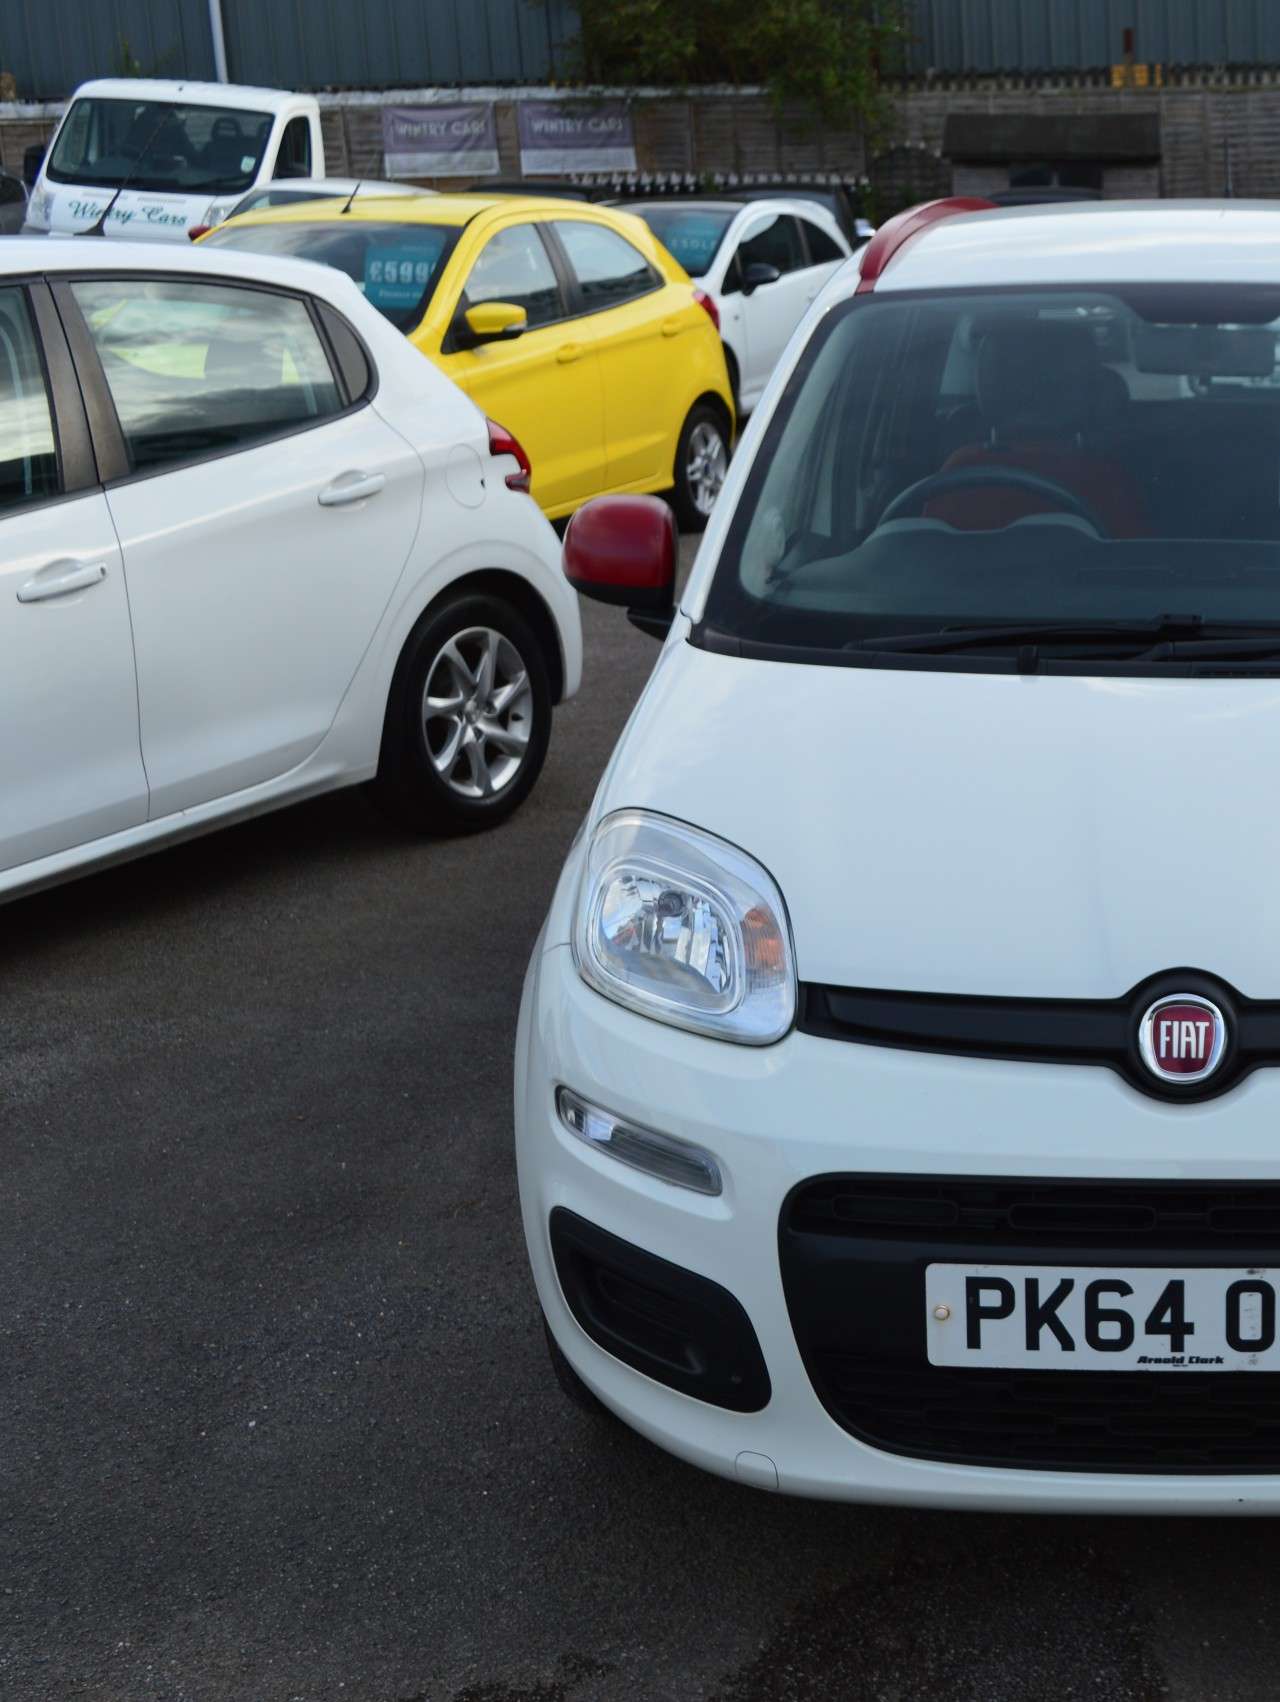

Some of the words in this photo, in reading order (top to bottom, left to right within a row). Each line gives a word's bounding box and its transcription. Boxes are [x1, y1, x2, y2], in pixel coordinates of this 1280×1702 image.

[398, 121, 447, 137] WINTRY
[530, 119, 582, 133] WINTRY
[588, 118, 624, 131] CARS
[68, 200, 137, 224] Winry
[142, 206, 187, 225] Cars
[1160, 1020, 1210, 1059] FIAT
[965, 1275, 1196, 1353] PK64
[1137, 1356, 1185, 1364] Arnold
[1188, 1356, 1224, 1364] Clark
